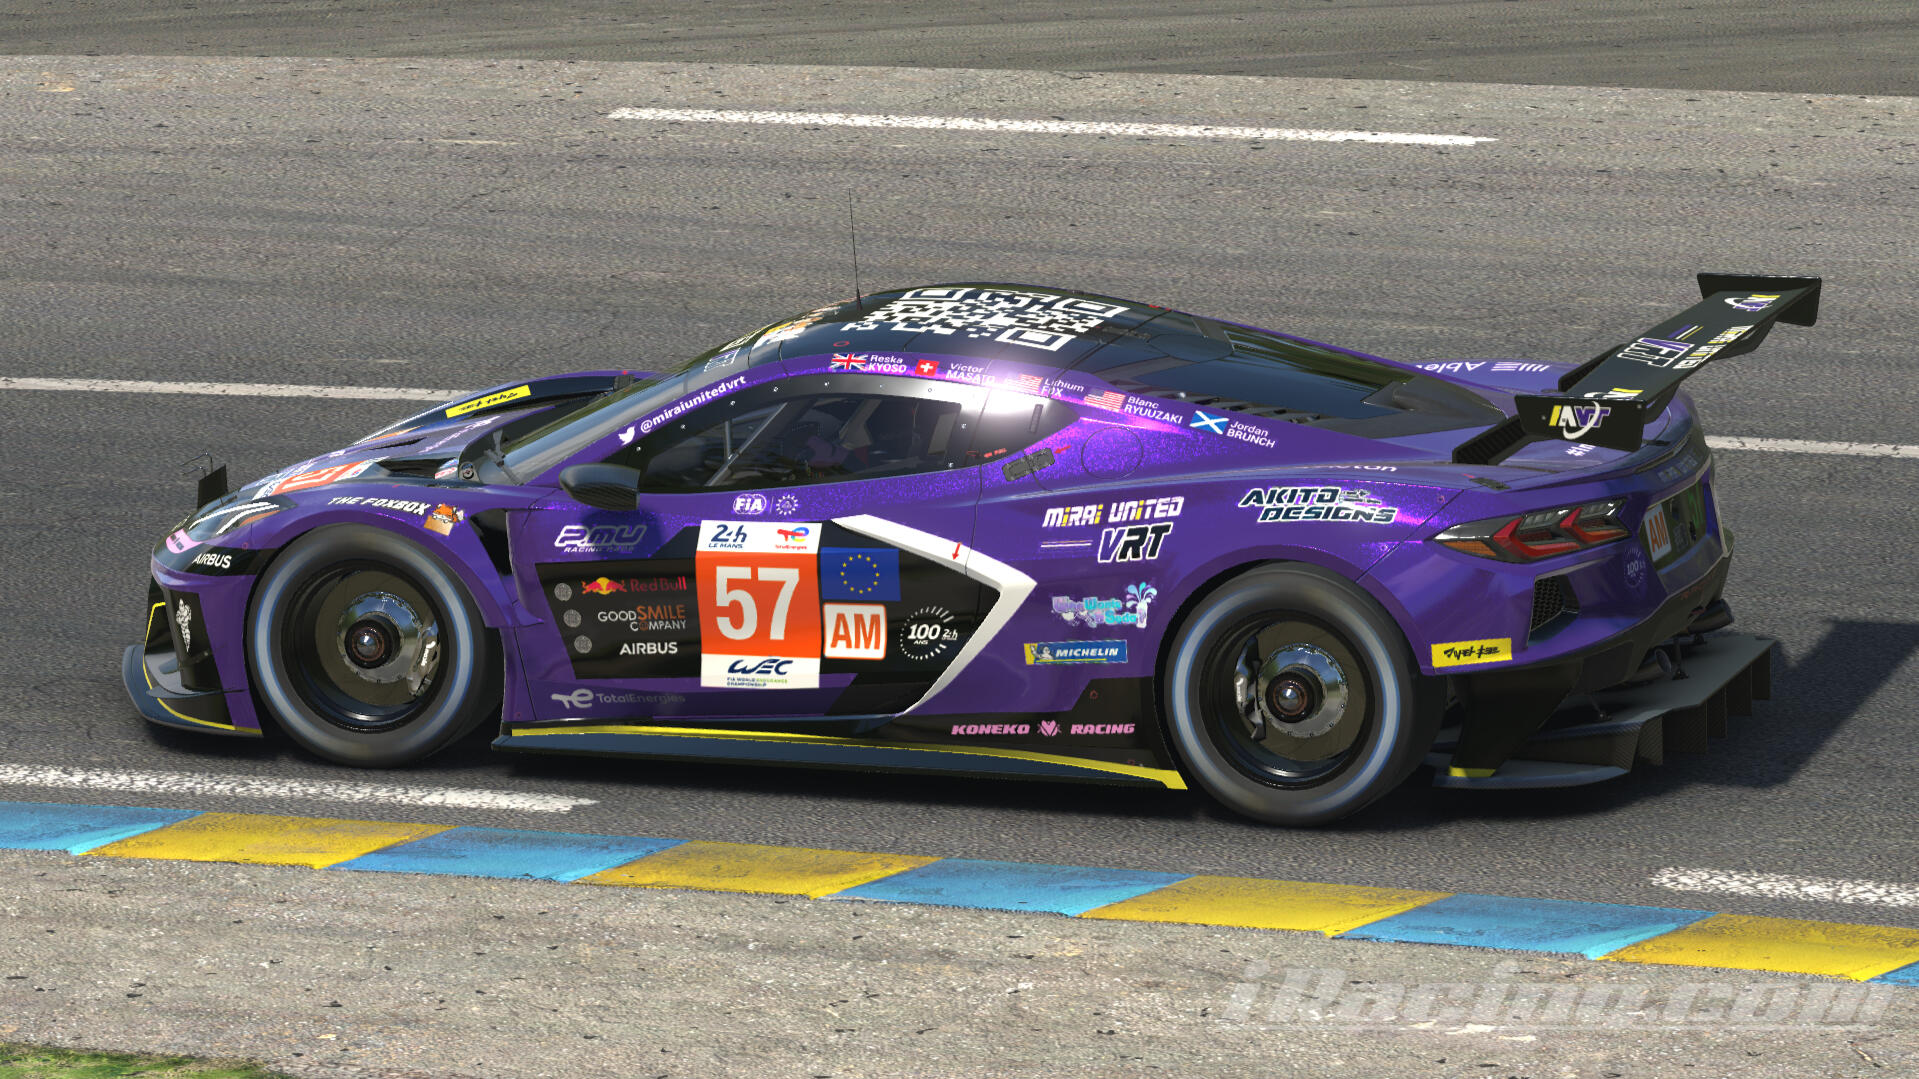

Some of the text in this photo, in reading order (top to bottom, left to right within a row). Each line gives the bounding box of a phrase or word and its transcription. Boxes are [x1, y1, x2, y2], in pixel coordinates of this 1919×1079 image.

[868, 362, 907, 373] KYOSO
[870, 354, 904, 364] Reska
[950, 363, 984, 373] Victor
[640, 376, 746, 433] @miraiunitedvrt
[1127, 396, 1159, 409] Blanc
[1124, 404, 1183, 424] RYUUZAKI
[1230, 421, 1269, 437] Jordan
[1226, 428, 1275, 448] BRUNCH
[327, 496, 431, 515] THE FOXBOX
[1238, 486, 1341, 508] AKITO
[1257, 506, 1399, 524] DESIGNS
[1648, 511, 1667, 552] AM
[1097, 522, 1173, 563] VRT
[191, 553, 232, 569] AIRBUS
[629, 576, 687, 592] Red Bull
[715, 566, 799, 640] 57
[597, 604, 686, 622] GOOD SMILE
[830, 613, 881, 649] AM
[907, 623, 941, 640] 100
[619, 641, 678, 655] AIRBUS
[1055, 648, 1119, 658] MICHELIN
[727, 658, 793, 675] WEC
[595, 693, 686, 704] TotalEnergies
[951, 723, 1135, 735] KONEKO RACING
